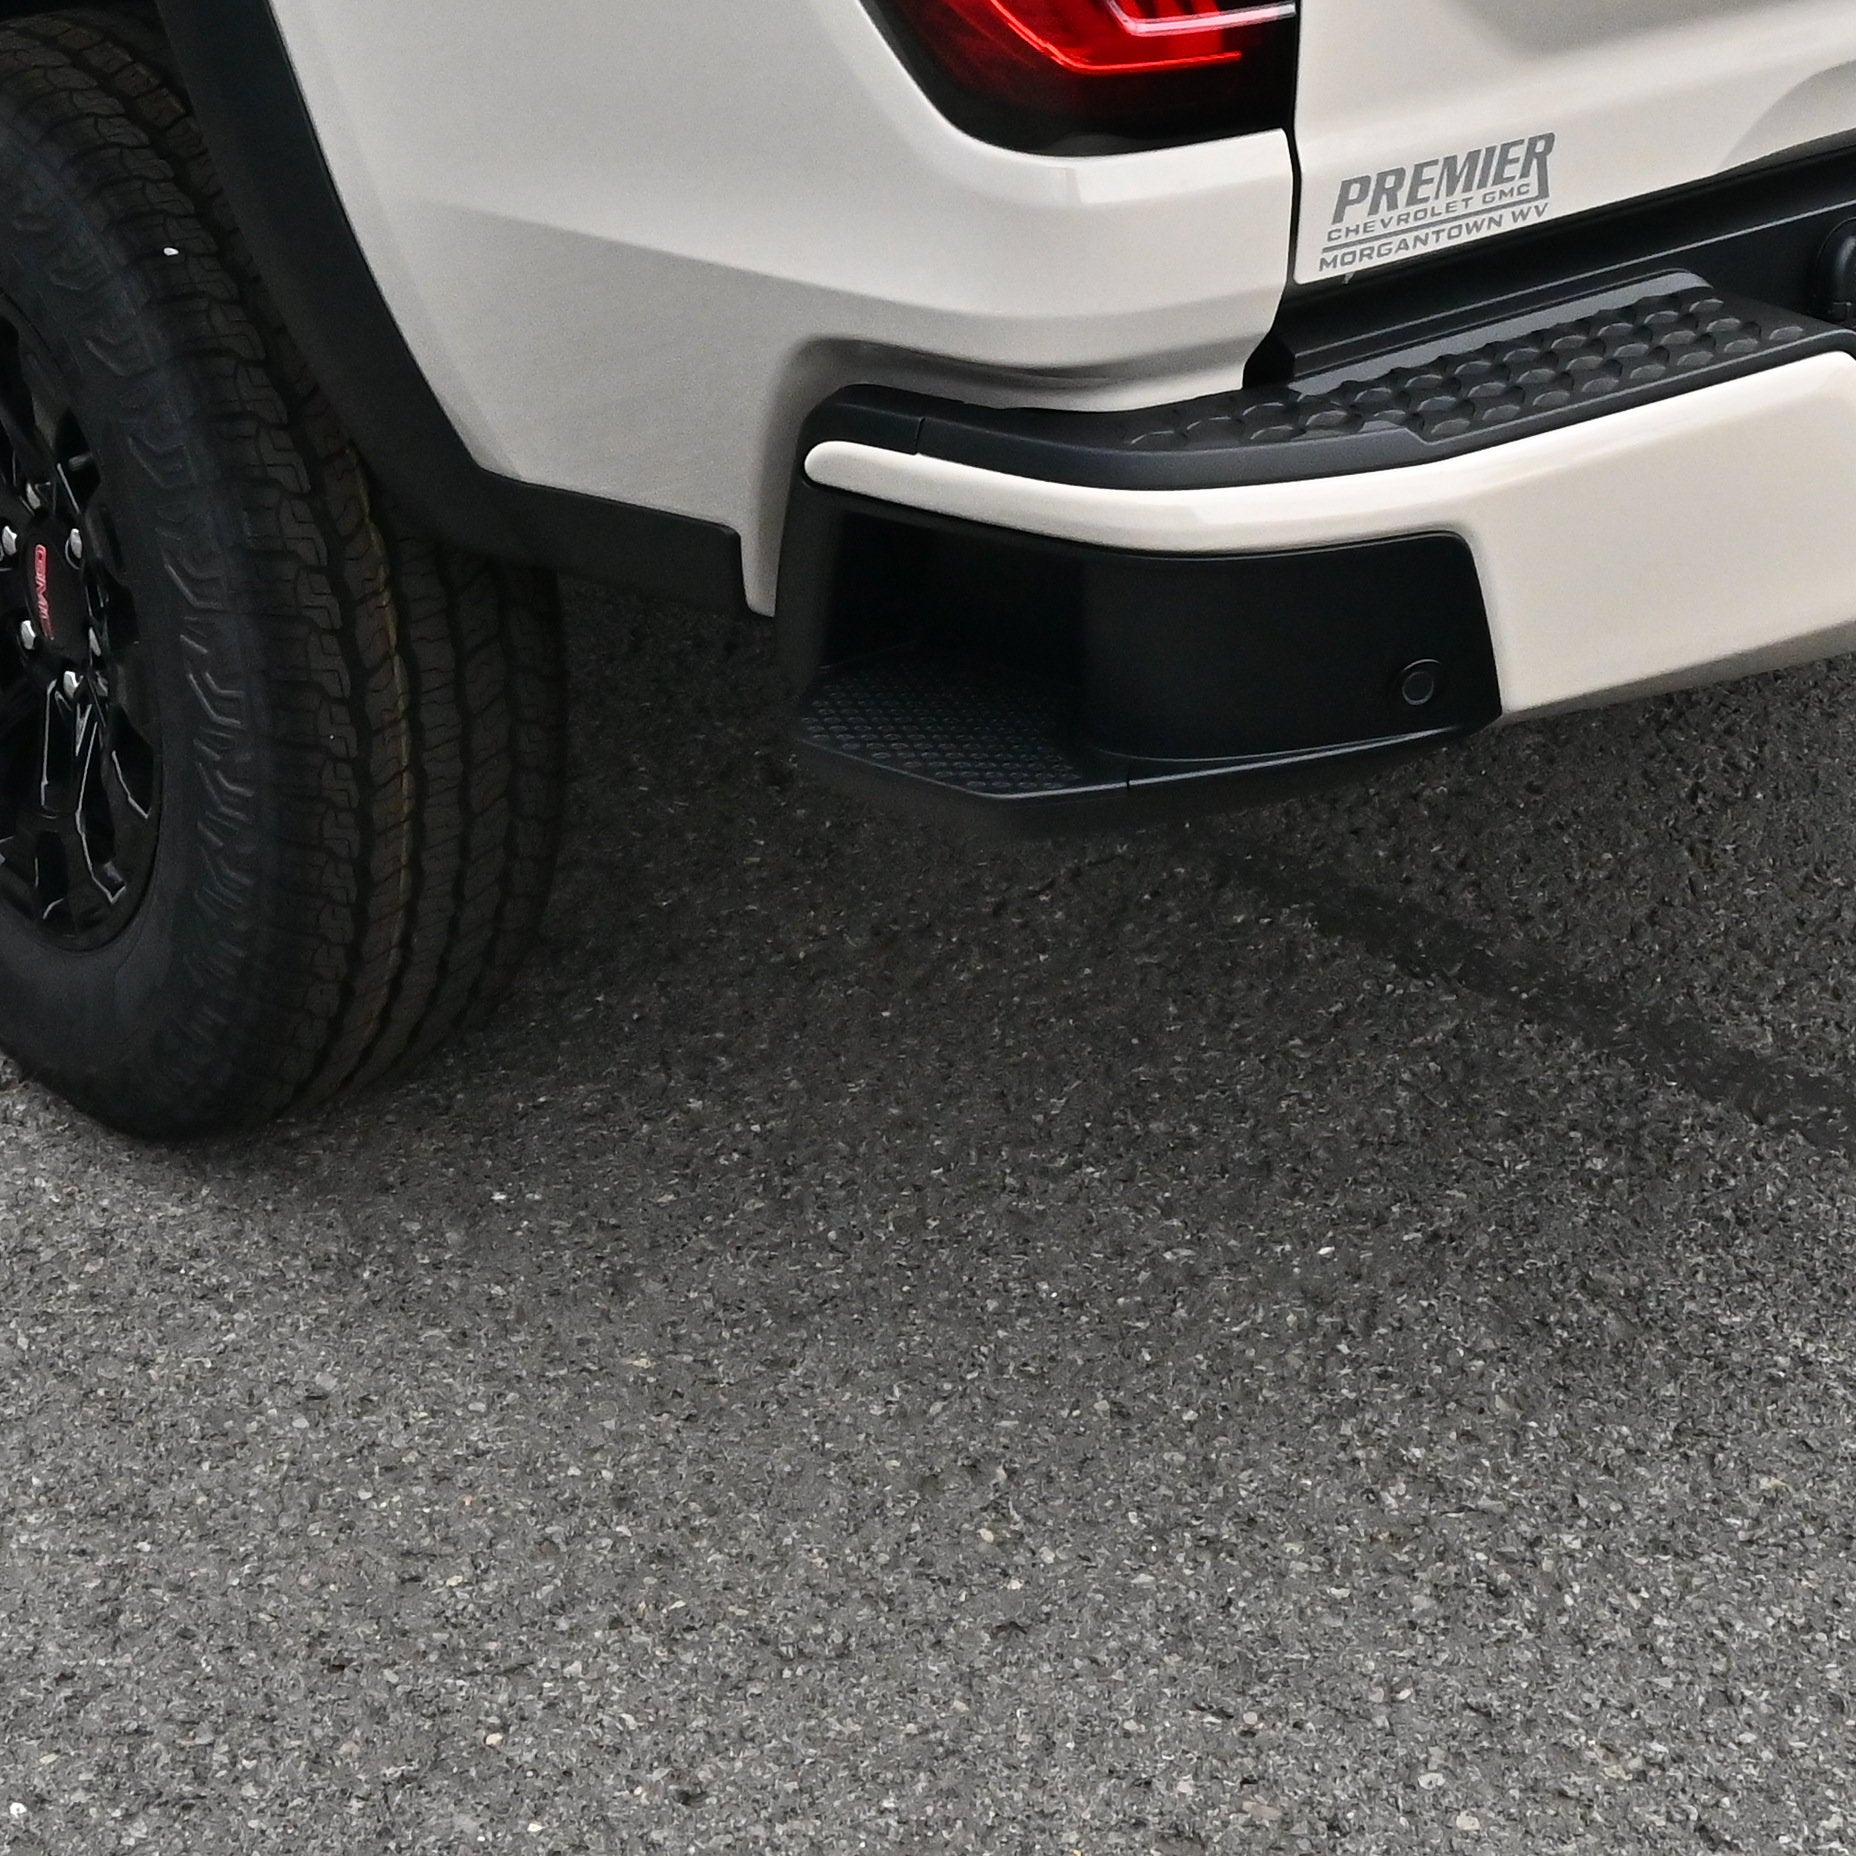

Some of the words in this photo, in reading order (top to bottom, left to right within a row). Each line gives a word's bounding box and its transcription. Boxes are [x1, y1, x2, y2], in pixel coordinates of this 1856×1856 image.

[1327, 196, 1474, 243] CHEVROLET
[1482, 183, 1531, 205] GMC
[1331, 132, 1556, 225] PREMIER
[1319, 214, 1502, 272] MORGANTOWN
[1511, 202, 1550, 224] WV
